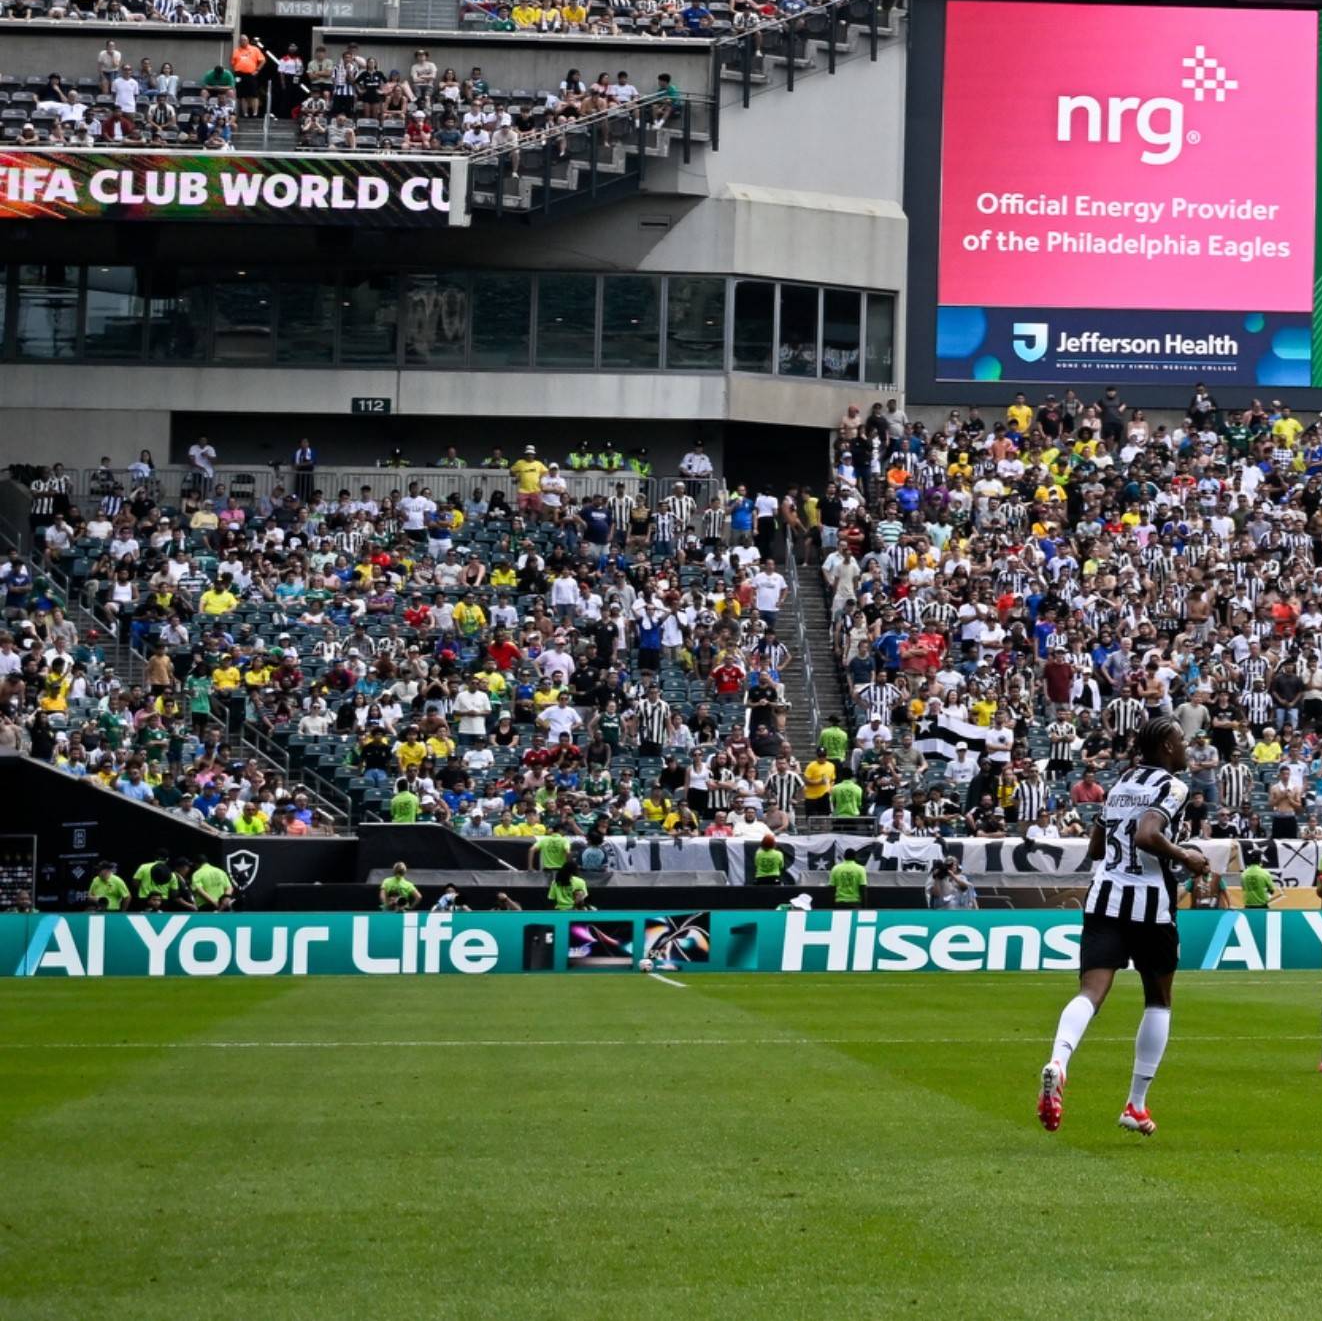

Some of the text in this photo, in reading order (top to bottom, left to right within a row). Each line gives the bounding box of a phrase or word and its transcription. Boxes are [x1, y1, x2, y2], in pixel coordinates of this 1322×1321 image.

[276, 1, 313, 16] M13
[1057, 95, 1185, 165] nrg
[0, 167, 79, 204] IFA
[90, 170, 208, 206] CLUB
[221, 173, 388, 210] WORLD
[977, 192, 1279, 224] Official Energy Provider
[963, 230, 1290, 263] of the Philadelphia Eagles
[1056, 332, 1238, 356] Jefferson Health
[357, 399, 385, 411] 112
[1106, 819, 1143, 875] 31
[14, 912, 499, 976] AI Your Life
[781, 910, 1084, 971] Hisens
[1201, 911, 1282, 970] AI
